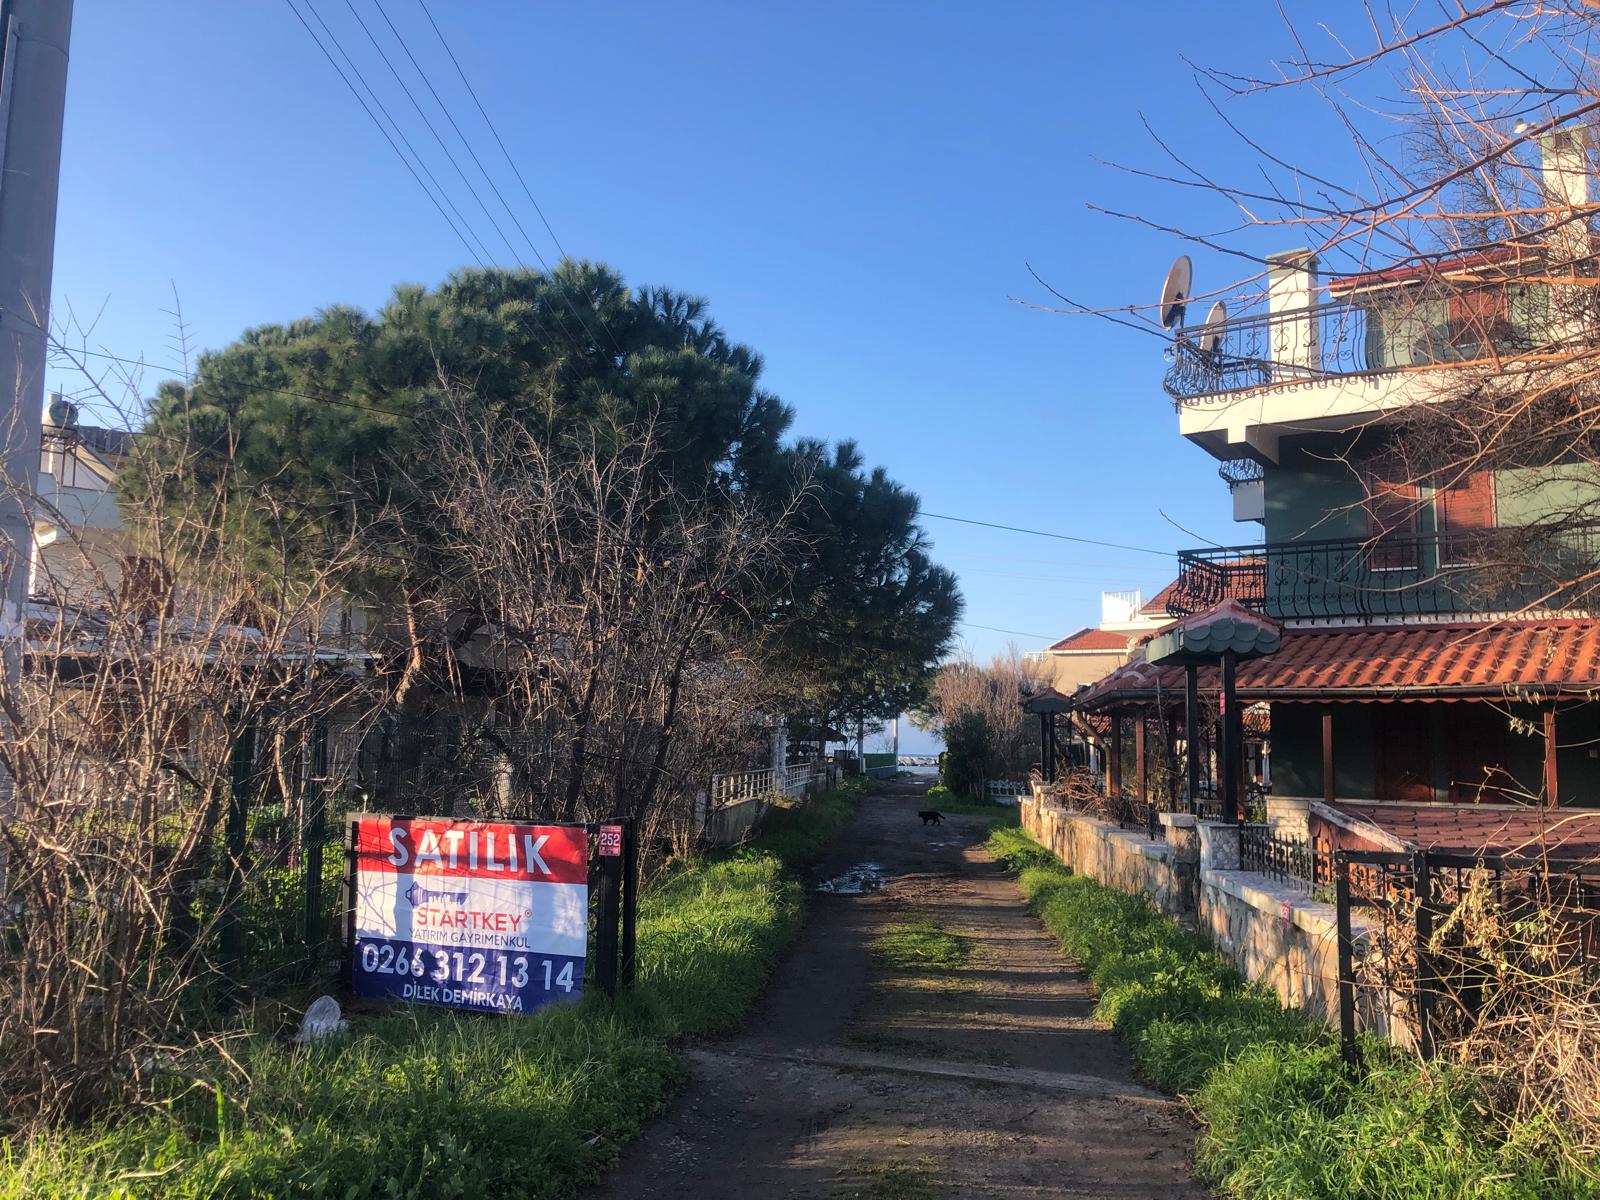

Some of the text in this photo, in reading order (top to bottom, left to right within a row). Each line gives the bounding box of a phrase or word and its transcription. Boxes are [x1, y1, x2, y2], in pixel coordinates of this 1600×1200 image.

[387, 827, 552, 875] SATILIK
[601, 832, 620, 846] 252
[417, 907, 522, 932] STARTKEY
[409, 928, 531, 949] YATIRIM GAYRİMENKUL
[362, 943, 574, 993] 0266 312 13 14
[403, 981, 523, 1011] DİLEK DEMİRKAYA
